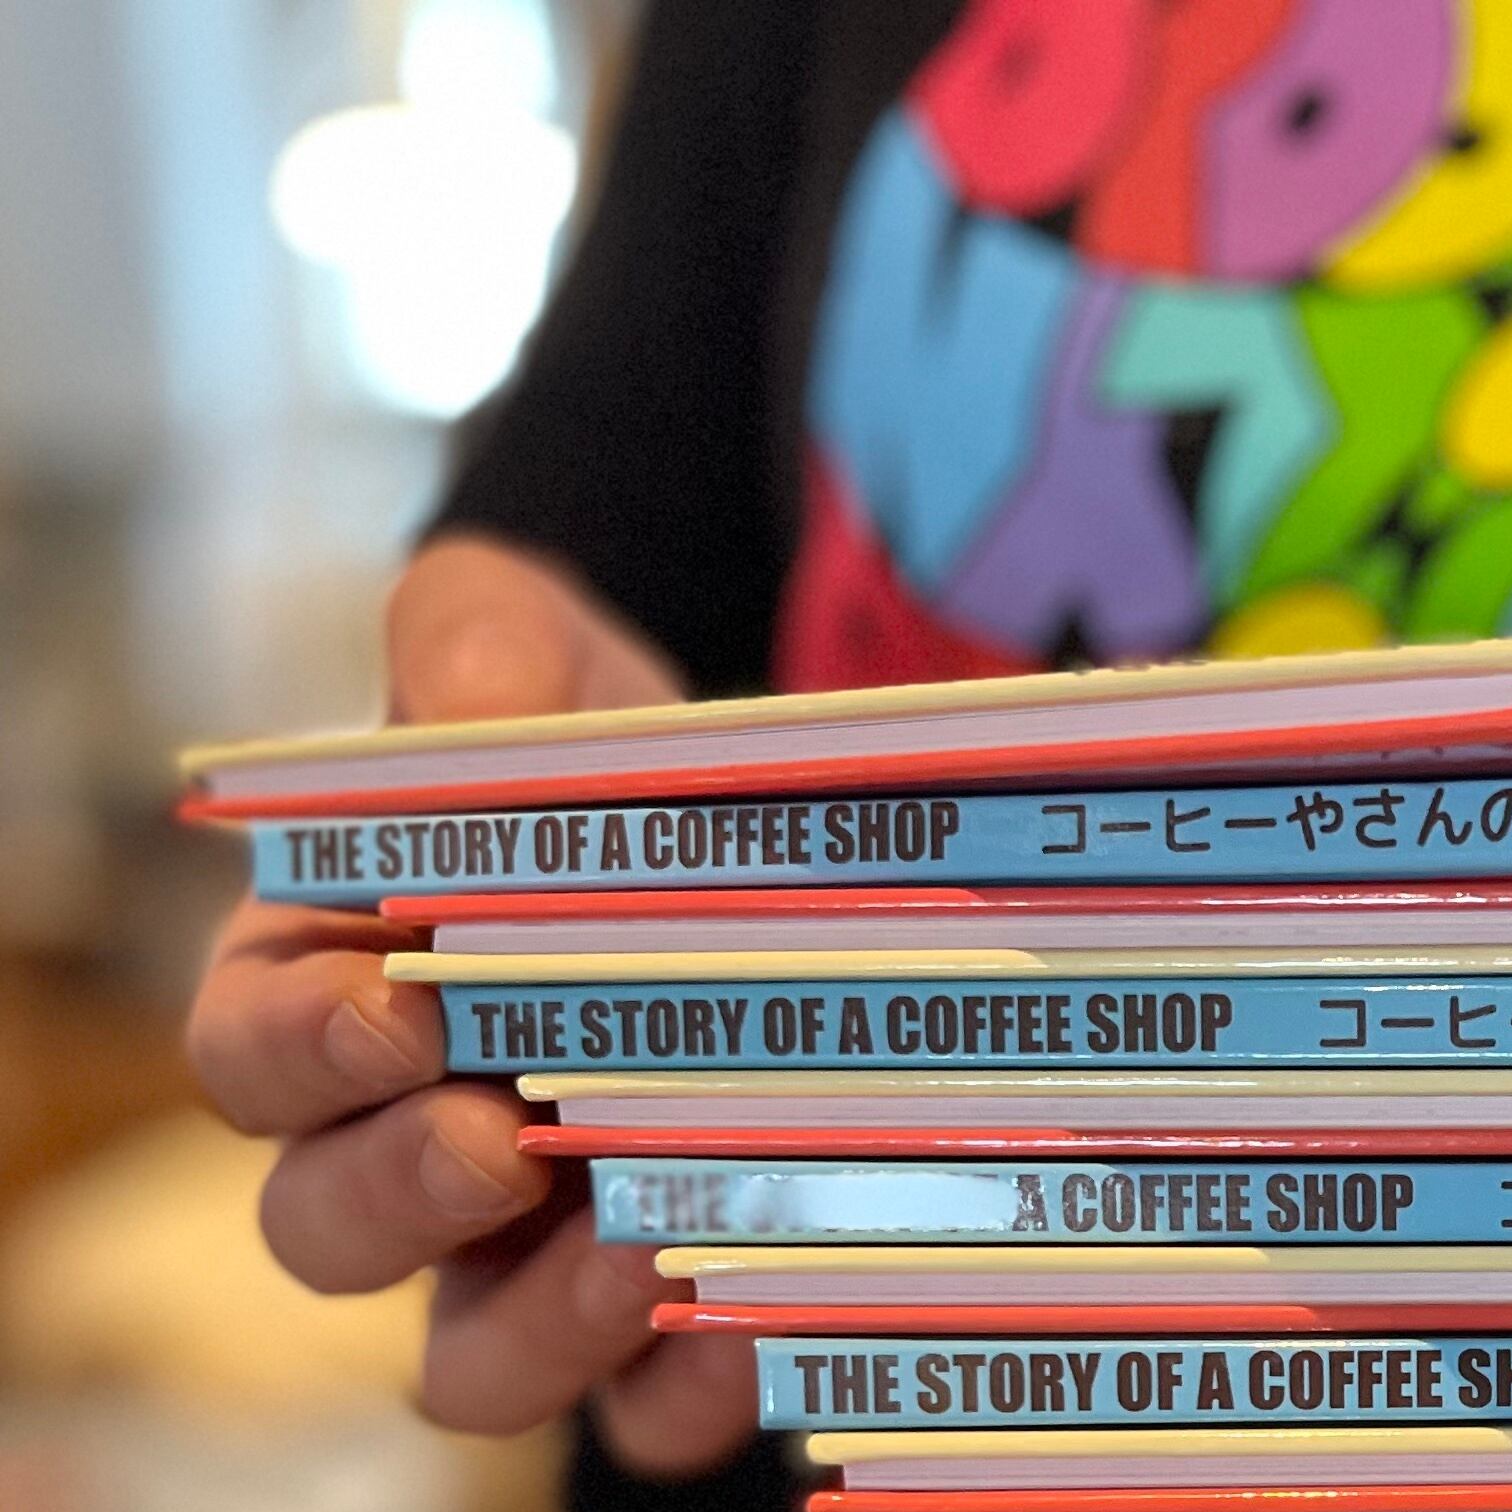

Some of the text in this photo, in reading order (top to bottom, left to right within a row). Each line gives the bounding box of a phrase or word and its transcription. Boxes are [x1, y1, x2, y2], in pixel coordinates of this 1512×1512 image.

[286, 800, 961, 882] THE STORY OF A COFFEE SHOP
[470, 993, 1233, 1061] THE STORY OF A COFFEE SHOP
[1014, 1174, 1049, 1232] A
[1062, 1173, 1253, 1233] COFFEE
[1266, 1173, 1414, 1233] SHOP
[795, 1354, 902, 1415] THE
[916, 1353, 1102, 1415] STORY
[1117, 1352, 1184, 1413] OF
[1196, 1351, 1235, 1411] A
[1249, 1350, 1444, 1411] COFFEE
